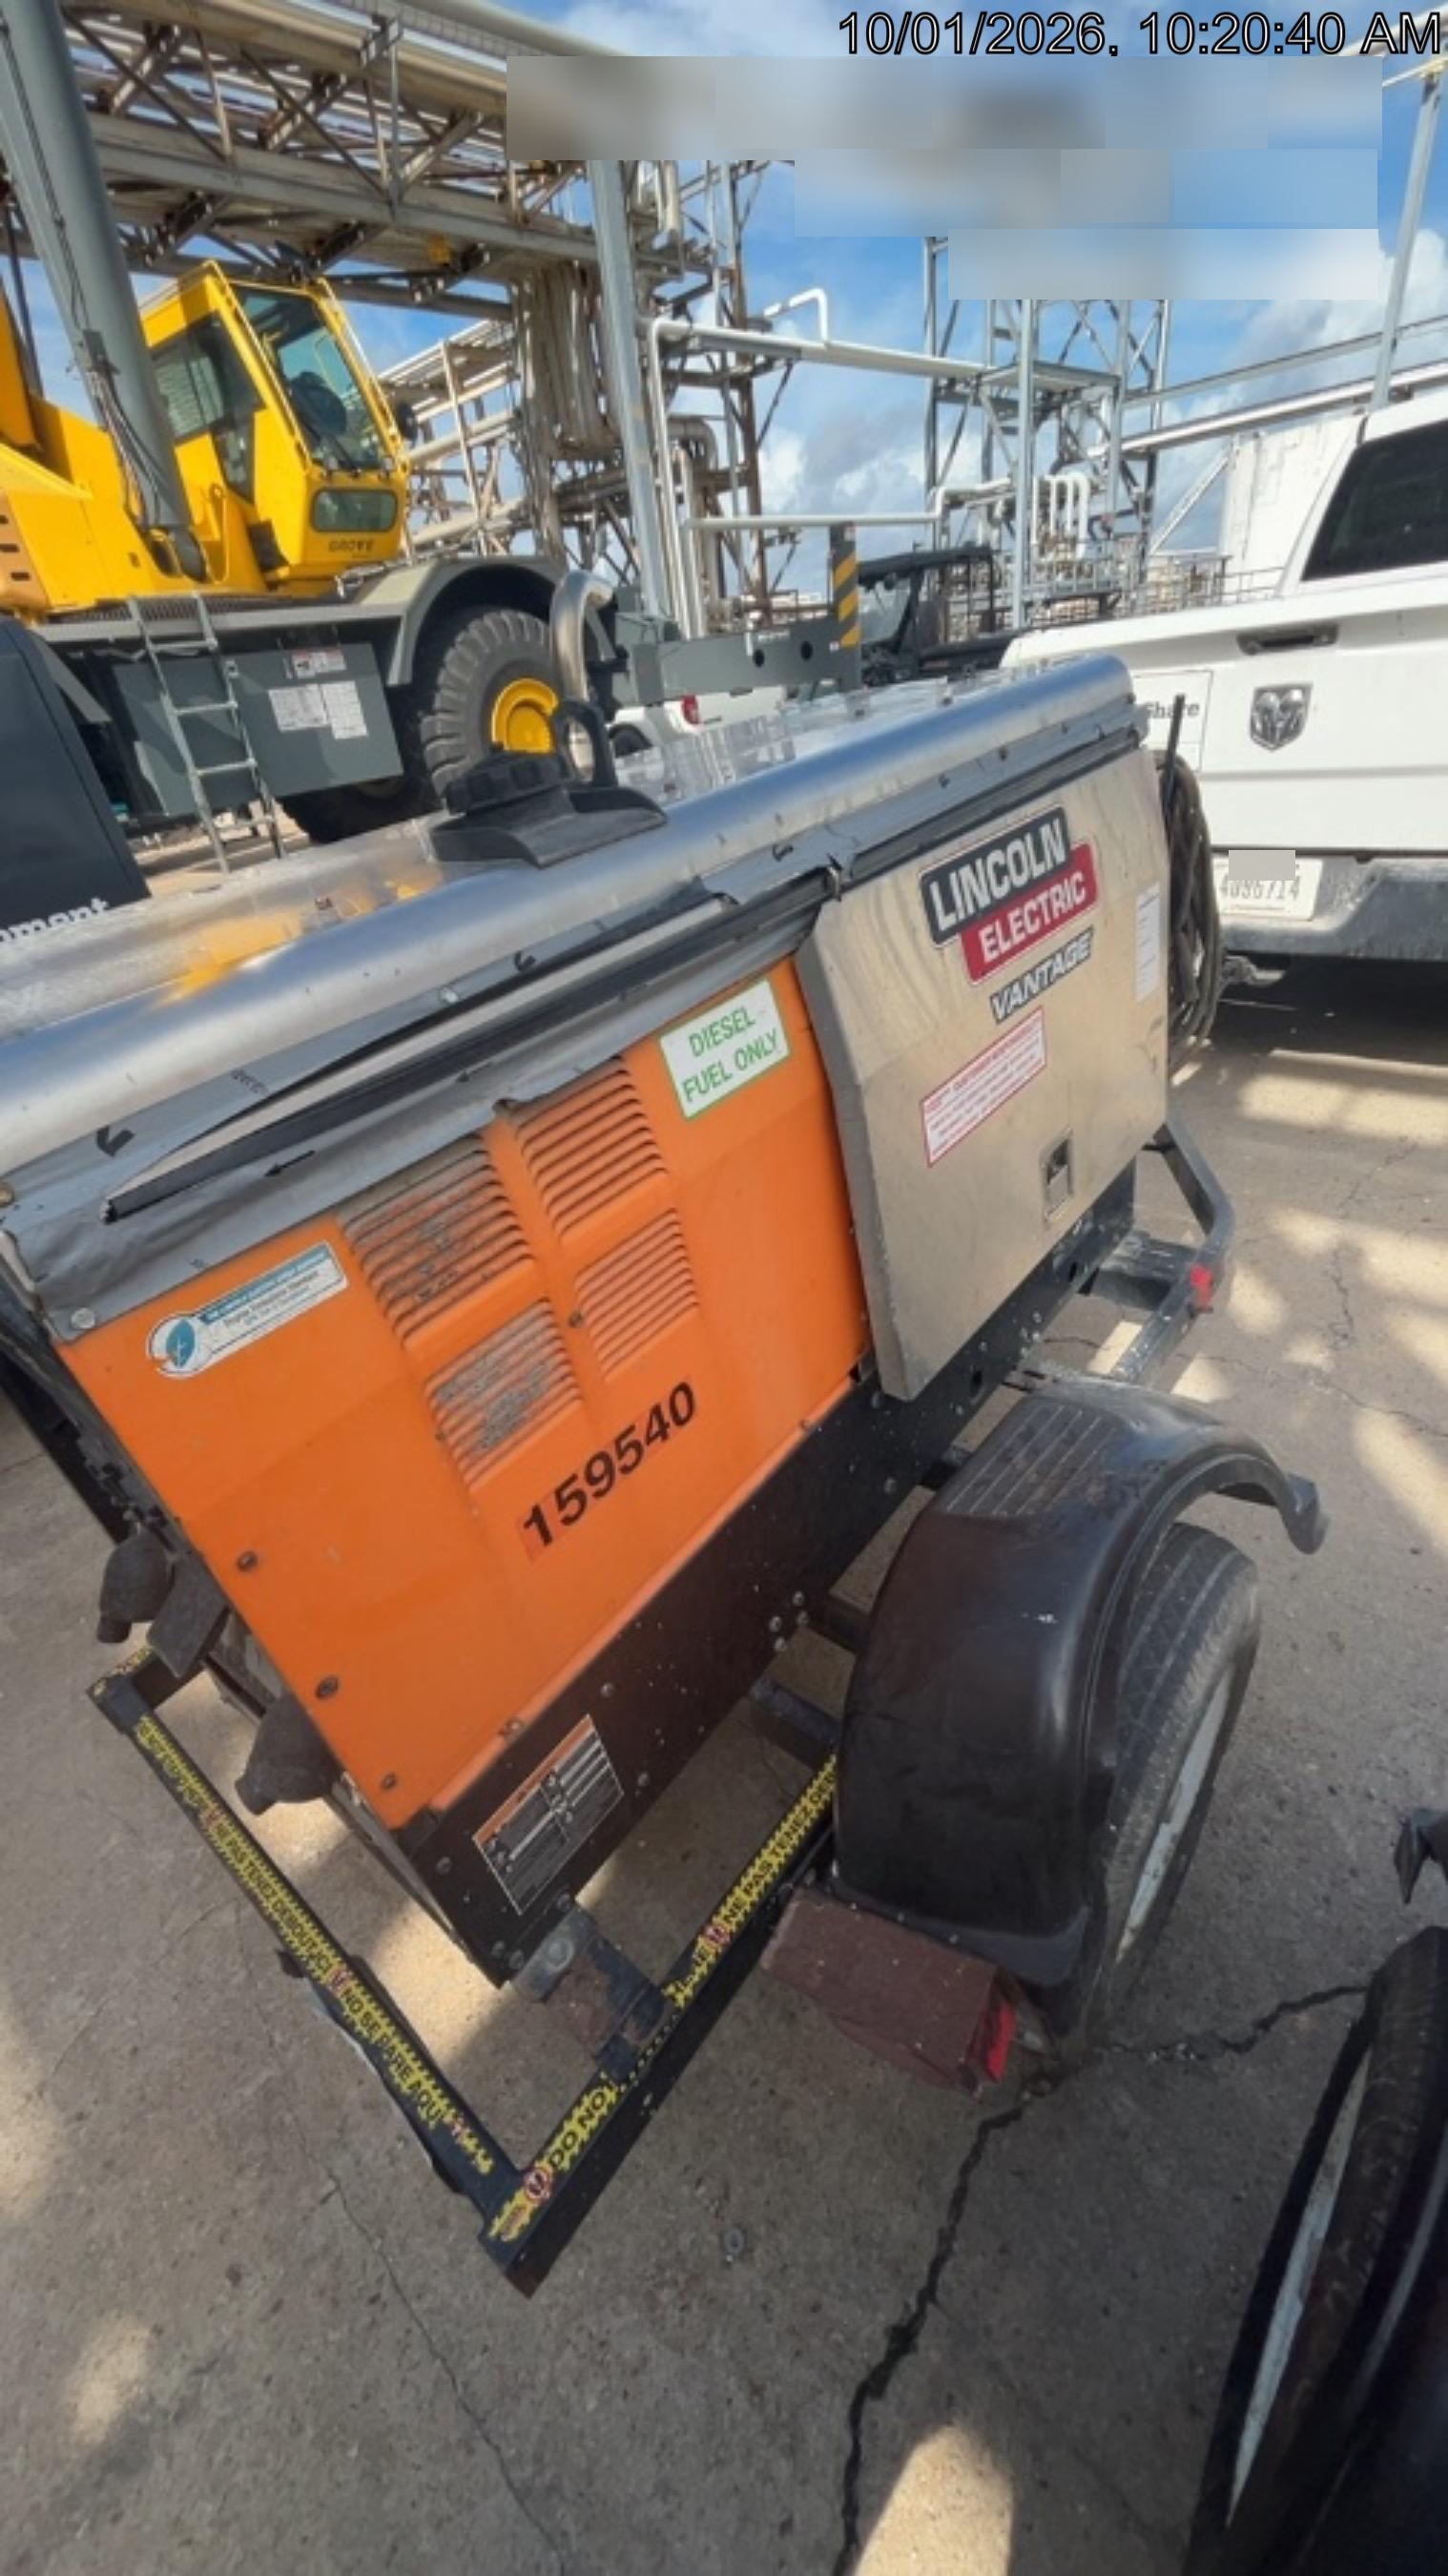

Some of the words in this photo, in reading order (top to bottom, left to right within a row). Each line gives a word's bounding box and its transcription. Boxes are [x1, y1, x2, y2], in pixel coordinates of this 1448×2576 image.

[930, 818, 1065, 932] LINCOLN
[978, 871, 1086, 963] ELECTRIC
[992, 931, 1092, 1021] VANTAGE
[682, 1059, 733, 1102] FUEL
[734, 1028, 776, 1070] ONLY
[689, 1007, 755, 1057] DIESEL
[524, 1381, 694, 1547] 159540
[548, 2131, 578, 2167] DO
[578, 2086, 615, 2129] NO
